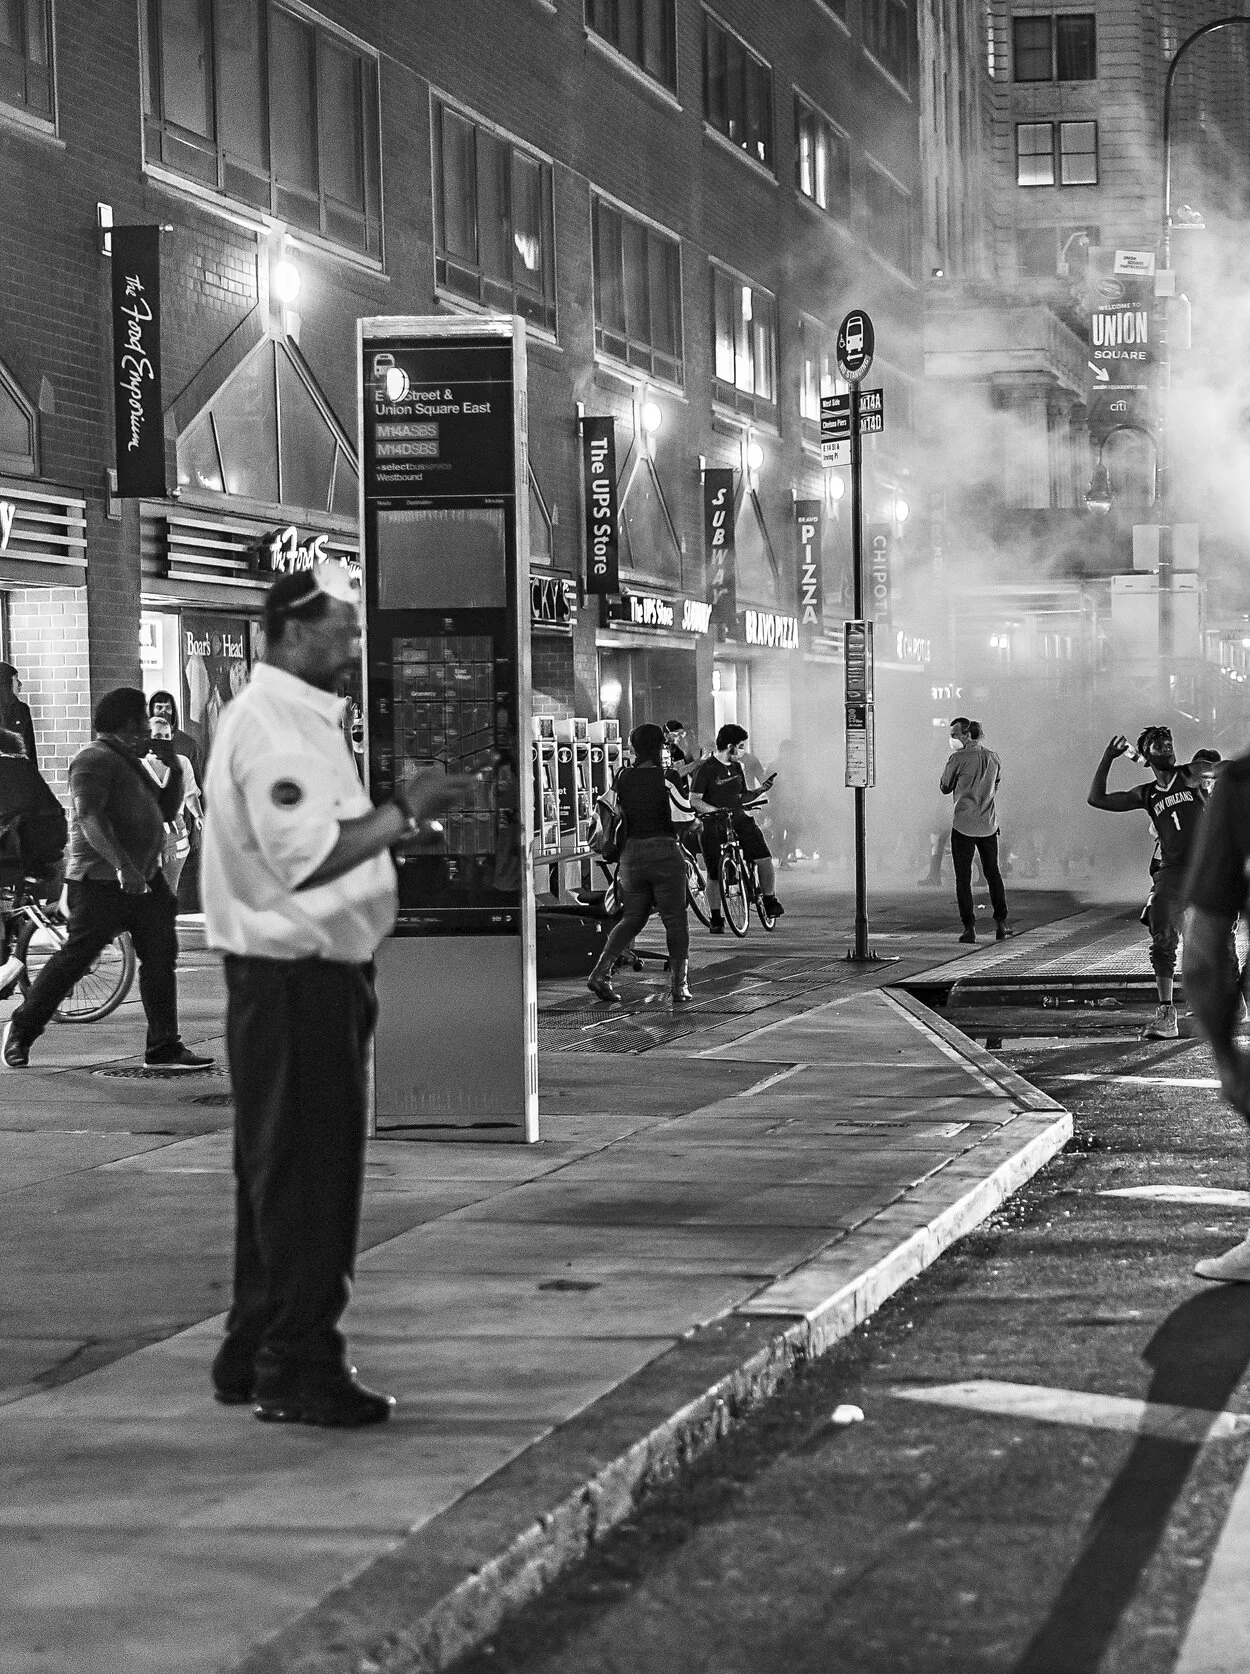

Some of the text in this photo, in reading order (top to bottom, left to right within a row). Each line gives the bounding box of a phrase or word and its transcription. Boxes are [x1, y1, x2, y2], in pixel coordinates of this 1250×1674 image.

[1098, 302, 1131, 311] WELCOME
[120, 297, 153, 356] Food
[1092, 311, 1148, 346] UNION
[1094, 350, 1146, 360] SQUARE
[119, 355, 155, 452] Emporium
[375, 390, 384, 401] E
[444, 388, 453, 400] &
[860, 393, 882, 411] M14A
[1110, 399, 1128, 411] citi
[375, 402, 491, 416] Union Square East
[860, 414, 882, 432] M14D
[376, 473, 423, 482] Westbound
[590, 437, 611, 575] The UPS Store
[711, 488, 728, 605] SUBWAY
[801, 524, 819, 625] PIZZA
[630, 596, 643, 624] The
[745, 610, 799, 649] BRAVO PIZZA
[186, 631, 244, 658] Boar's Head
[1153, 790, 1194, 817] NEW ORLEANS
[1170, 810, 1181, 831] 1
